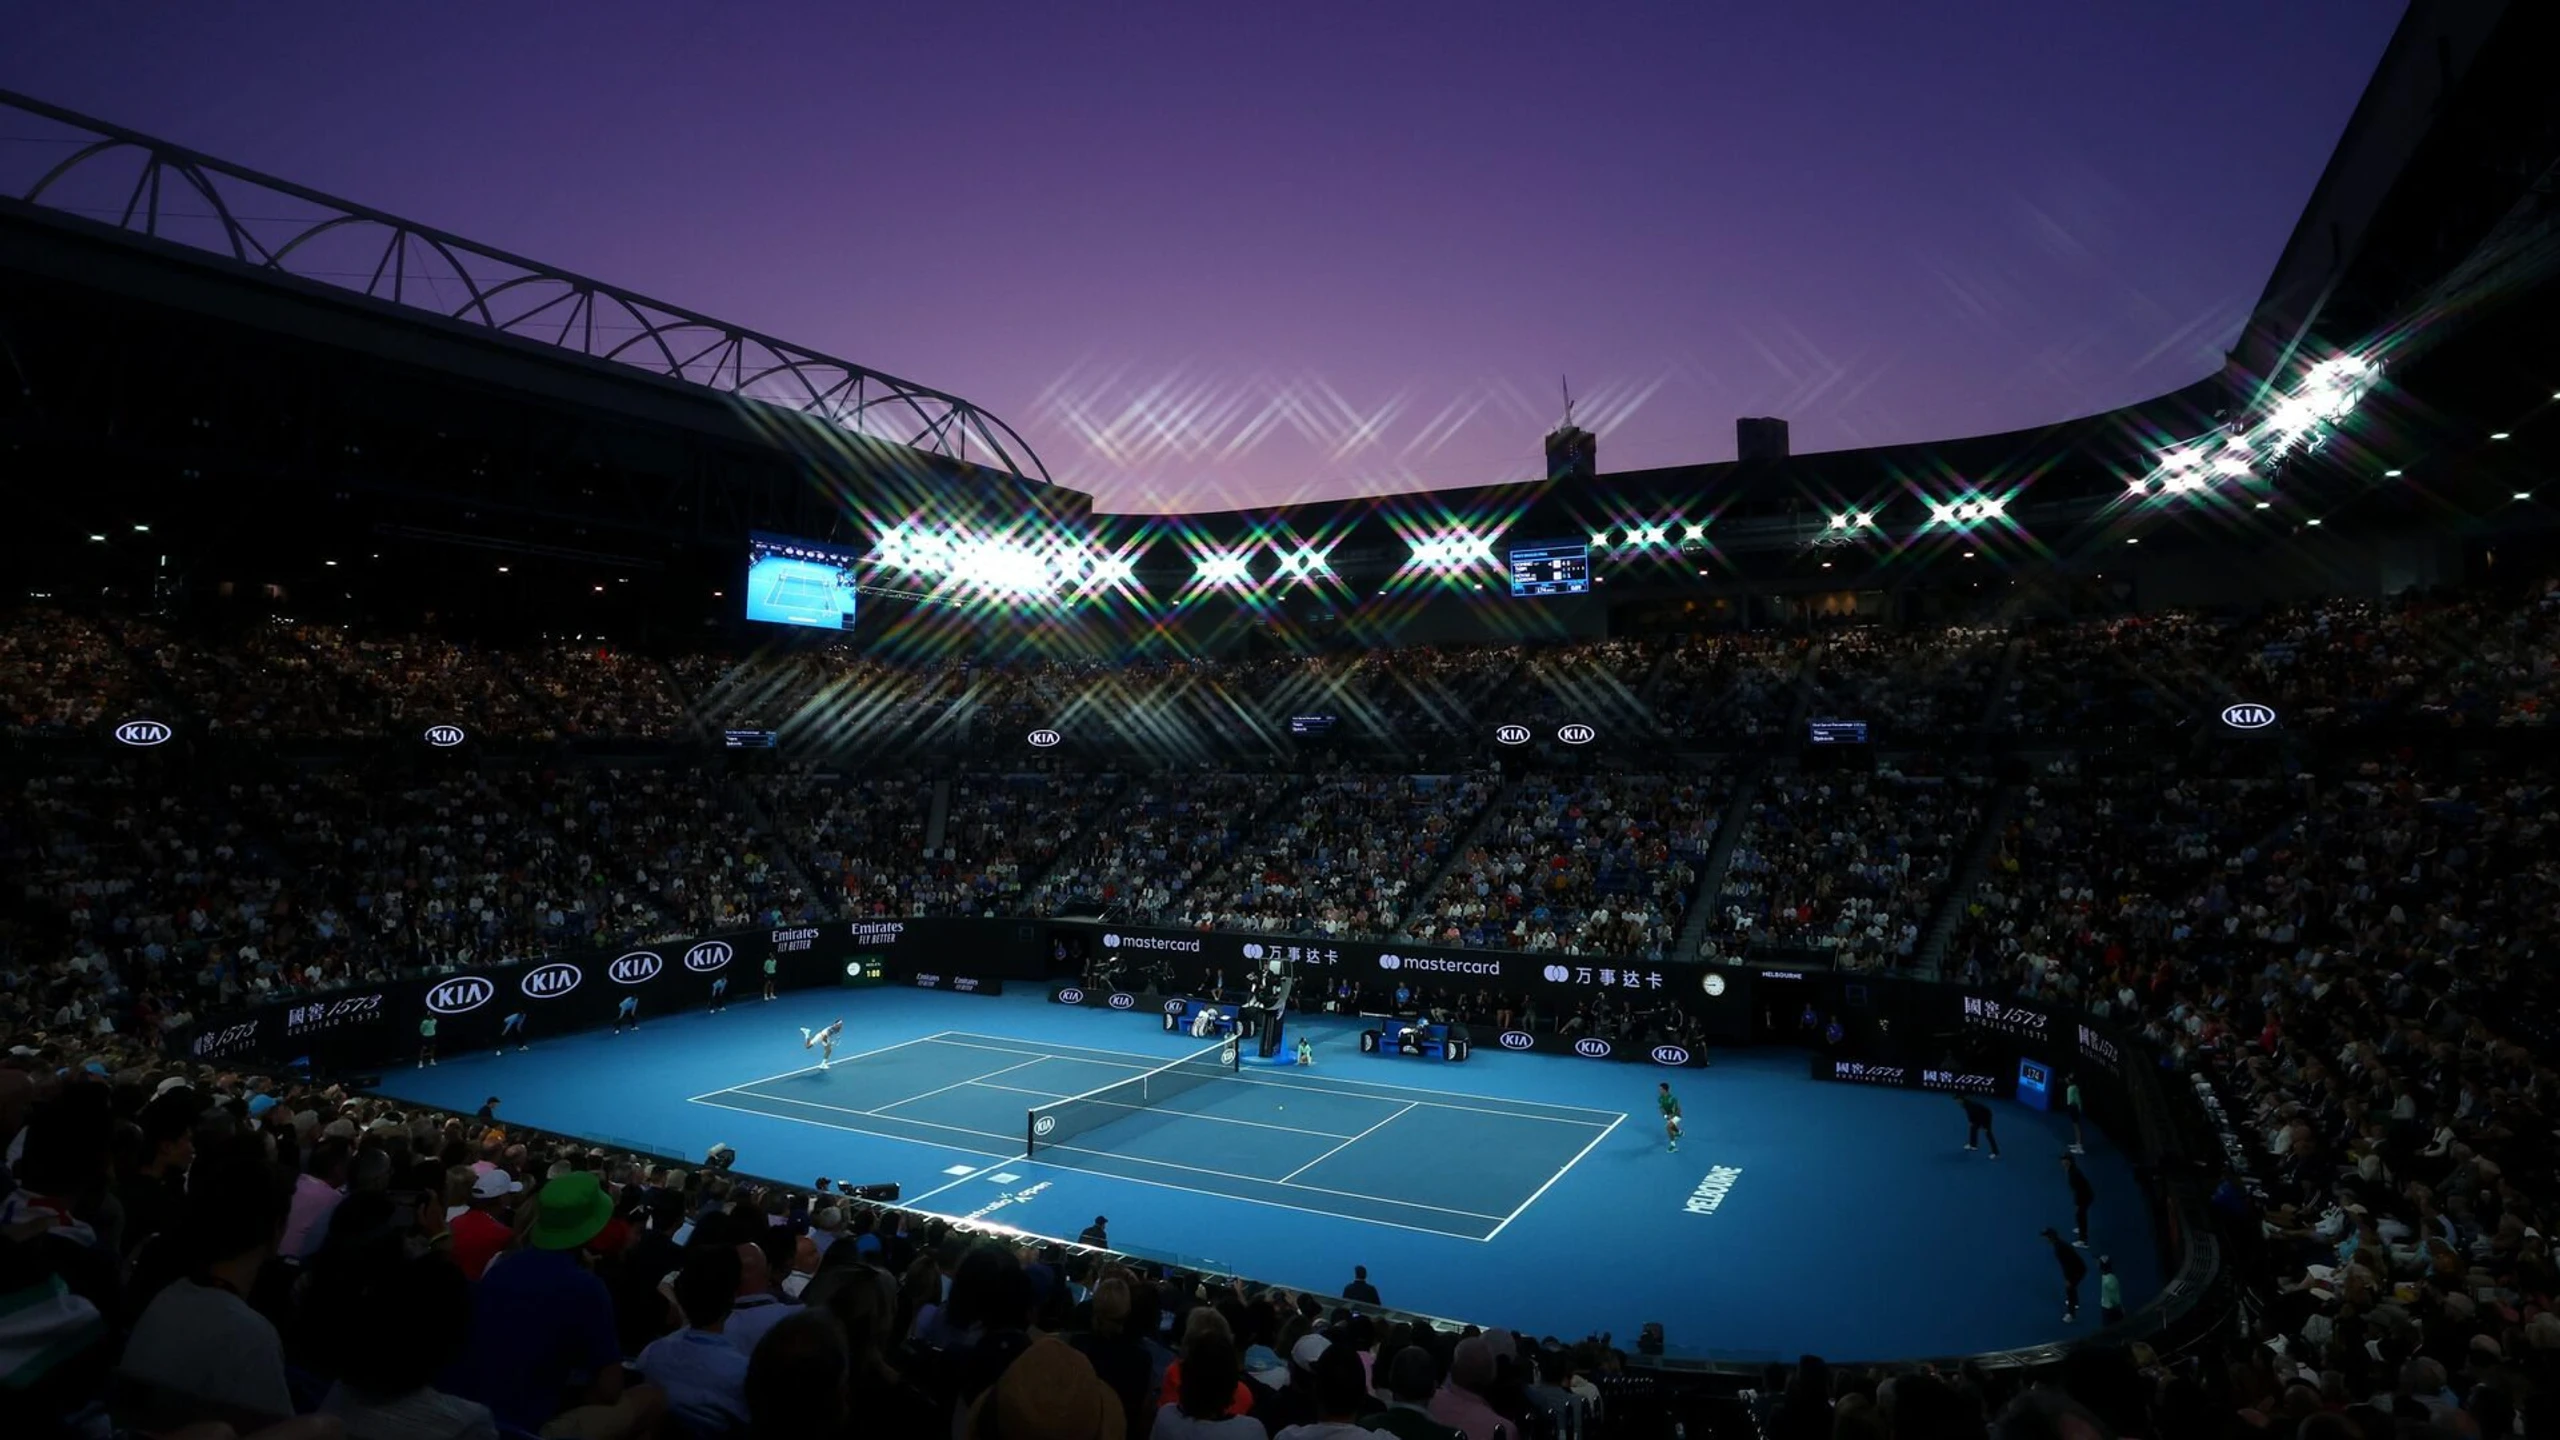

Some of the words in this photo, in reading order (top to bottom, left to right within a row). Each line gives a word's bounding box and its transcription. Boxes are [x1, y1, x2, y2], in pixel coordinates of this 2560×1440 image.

[2231, 709, 2266, 722] KIA
[126, 726, 162, 739] KIA
[432, 730, 457, 742] KIA
[1034, 733, 1054, 743] KIA
[1501, 729, 1524, 740] KIA
[1564, 729, 1589, 740] KIA
[852, 922, 904, 935] Emirates
[772, 928, 819, 943] Emirates
[871, 934, 896, 945] BETTER
[1123, 936, 1200, 952] mastercard
[693, 946, 725, 966] KIA
[1268, 945, 1339, 966] 万事达卡
[618, 957, 651, 978] KIA
[1404, 958, 1500, 975] mastercard
[533, 970, 571, 990] KIA
[1576, 967, 1663, 990] 万事达卡
[1762, 971, 1802, 980] MELBOURNE
[439, 983, 482, 1006] KIA
[1505, 1035, 1527, 1046] KIA
[1581, 1041, 1604, 1053] KIA
[1659, 1049, 1682, 1061] KIA
[1681, 1165, 1743, 1215] MELBOURNE
